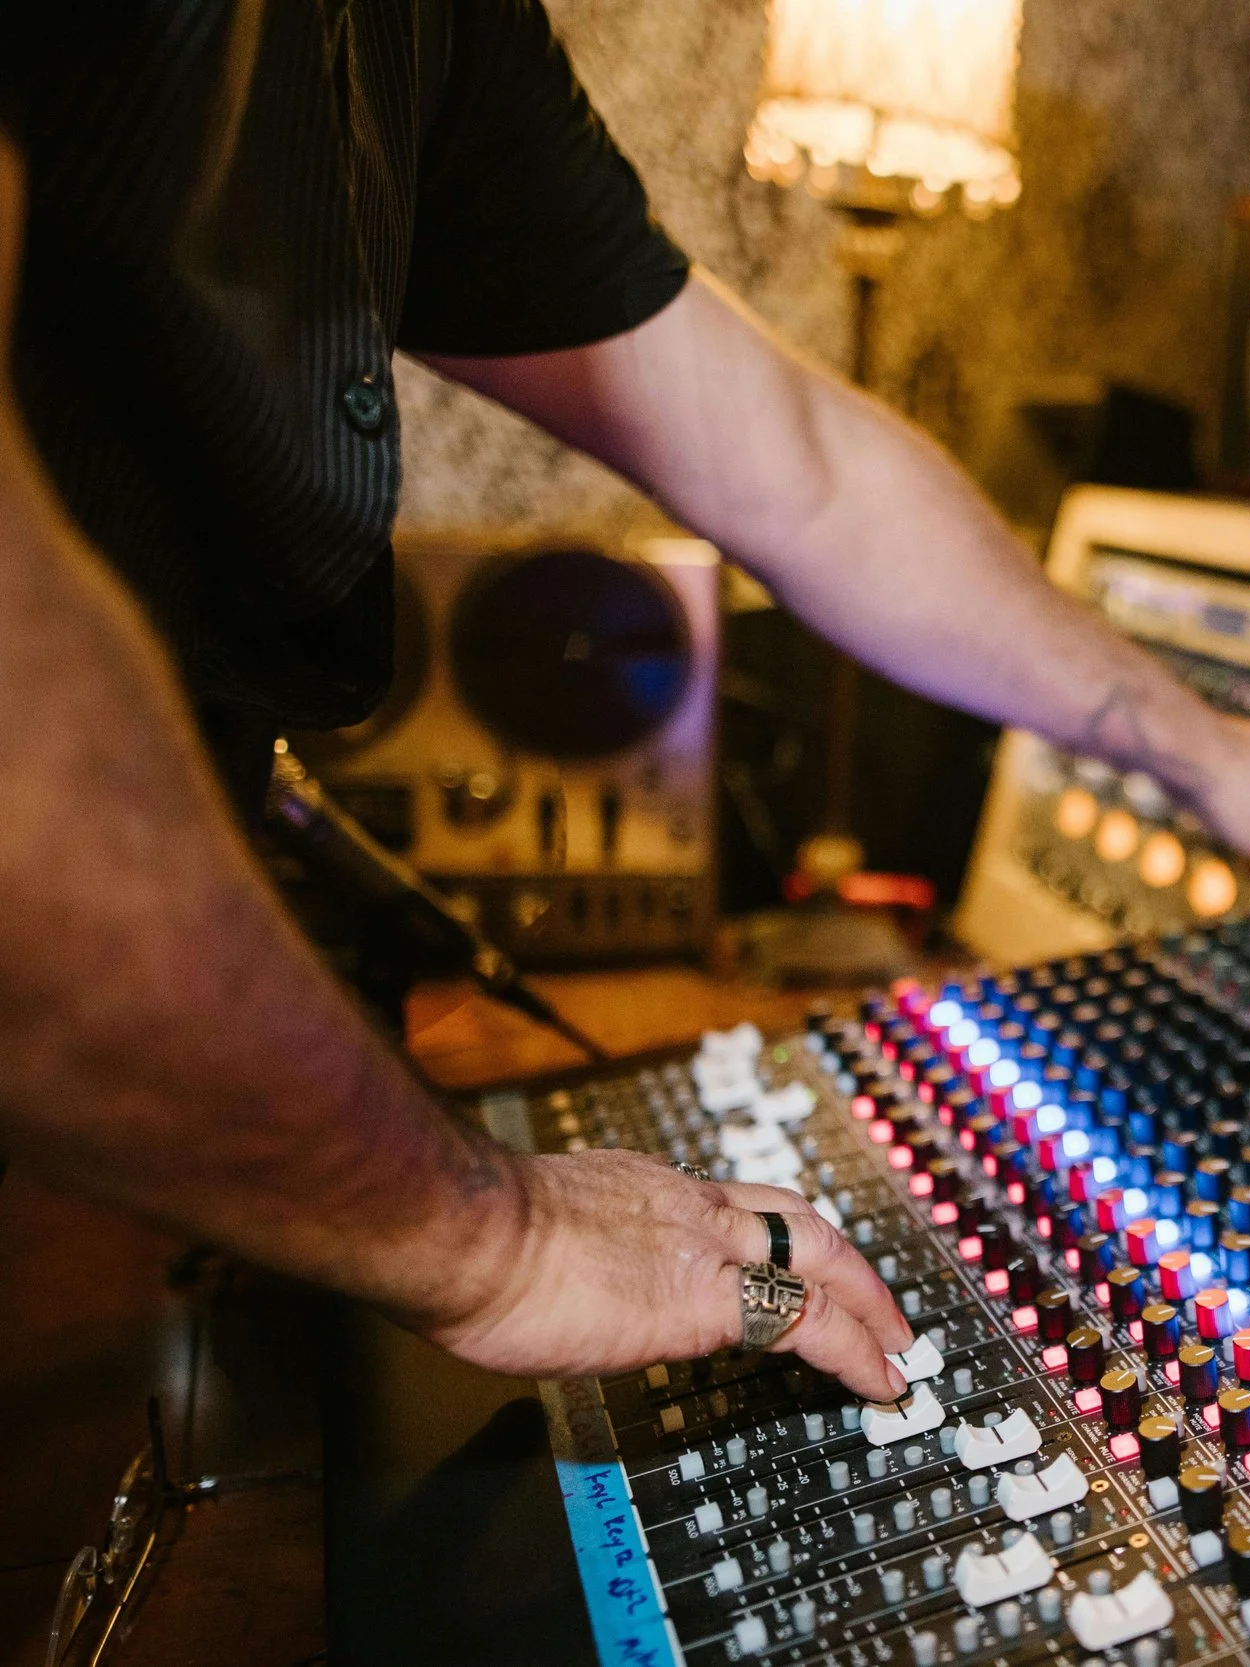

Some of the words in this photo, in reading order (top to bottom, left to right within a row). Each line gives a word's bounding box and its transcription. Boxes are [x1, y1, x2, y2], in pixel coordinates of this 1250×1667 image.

[1064, 1399, 1080, 1415] MUTE
[1189, 1418, 1202, 1431] MUTE
[1193, 1413, 1211, 1432] MONITOR
[1081, 1423, 1099, 1444] CHANNEL
[1066, 1447, 1078, 1463] SIGNAL
[1099, 1446, 1115, 1463] MUTE
[1206, 1442, 1218, 1454] MON
[668, 1469, 680, 1485] SOLO
[685, 1520, 698, 1538] SOLO
